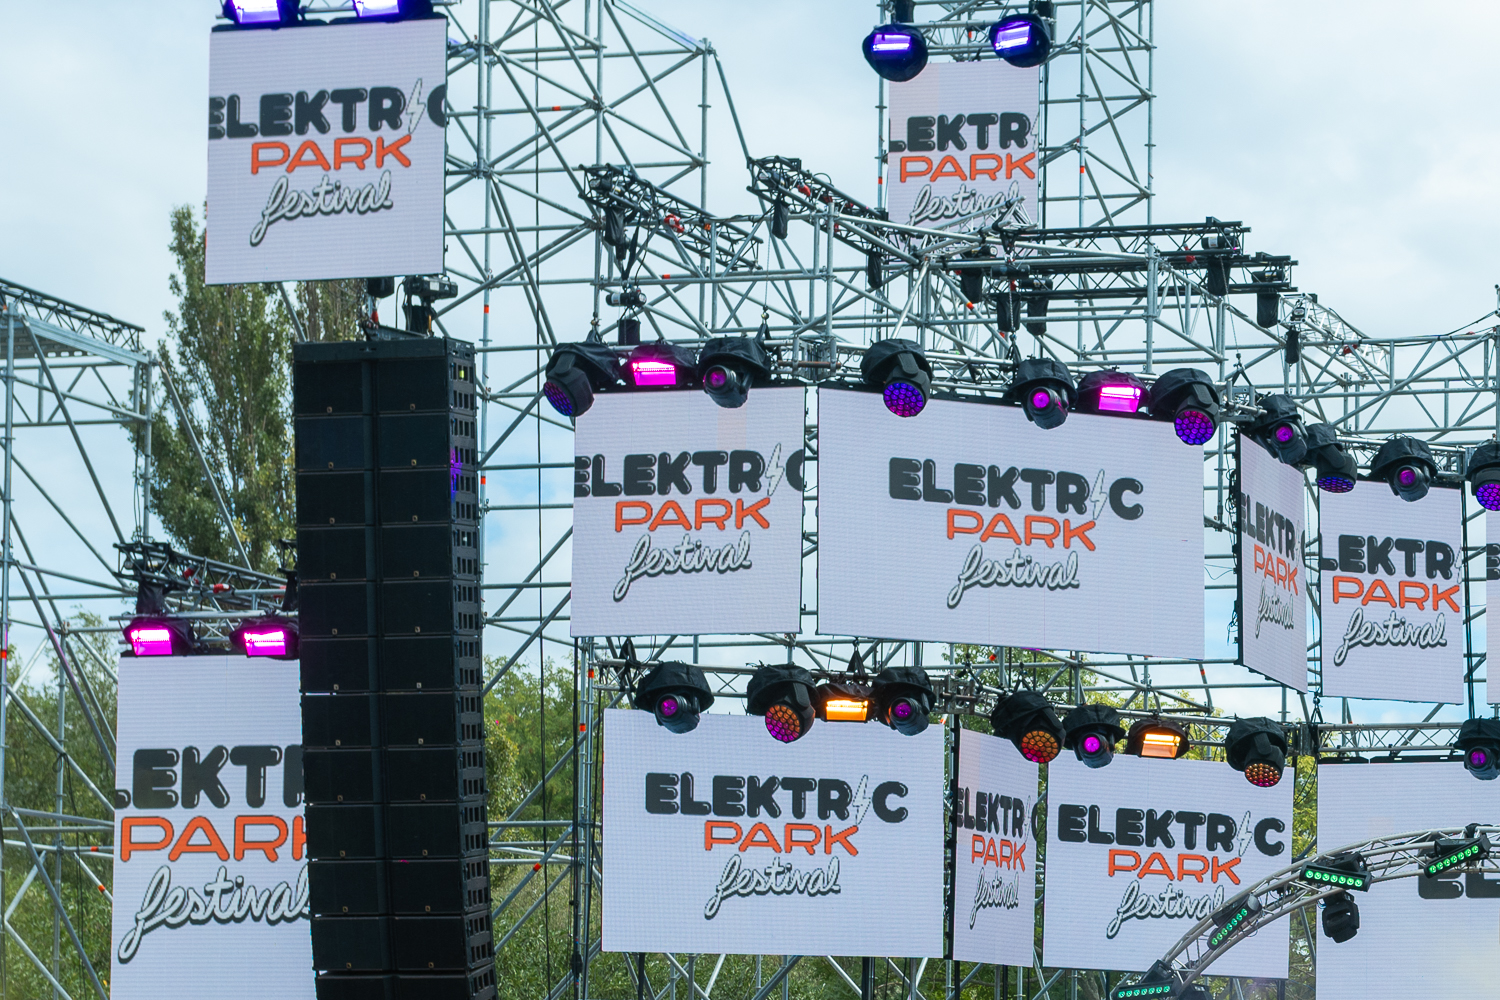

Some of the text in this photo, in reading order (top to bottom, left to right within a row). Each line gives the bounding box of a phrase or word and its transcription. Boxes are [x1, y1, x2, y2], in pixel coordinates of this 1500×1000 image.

[250, 134, 412, 175] PARK
[900, 152, 1036, 183] PARK
[249, 169, 394, 247] festival
[615, 497, 770, 532] PARK
[946, 508, 1096, 551] PARK
[613, 530, 752, 602] festival
[946, 543, 1080, 610] festival
[1253, 543, 1298, 596] PARK
[1255, 579, 1294, 639] festival
[1332, 575, 1460, 613] PARK
[1333, 607, 1447, 667] festival
[703, 819, 859, 856] PARK
[971, 833, 1026, 872] PARK
[704, 853, 841, 921] festival
[1108, 848, 1241, 885] PARK
[969, 867, 1019, 930] festival
